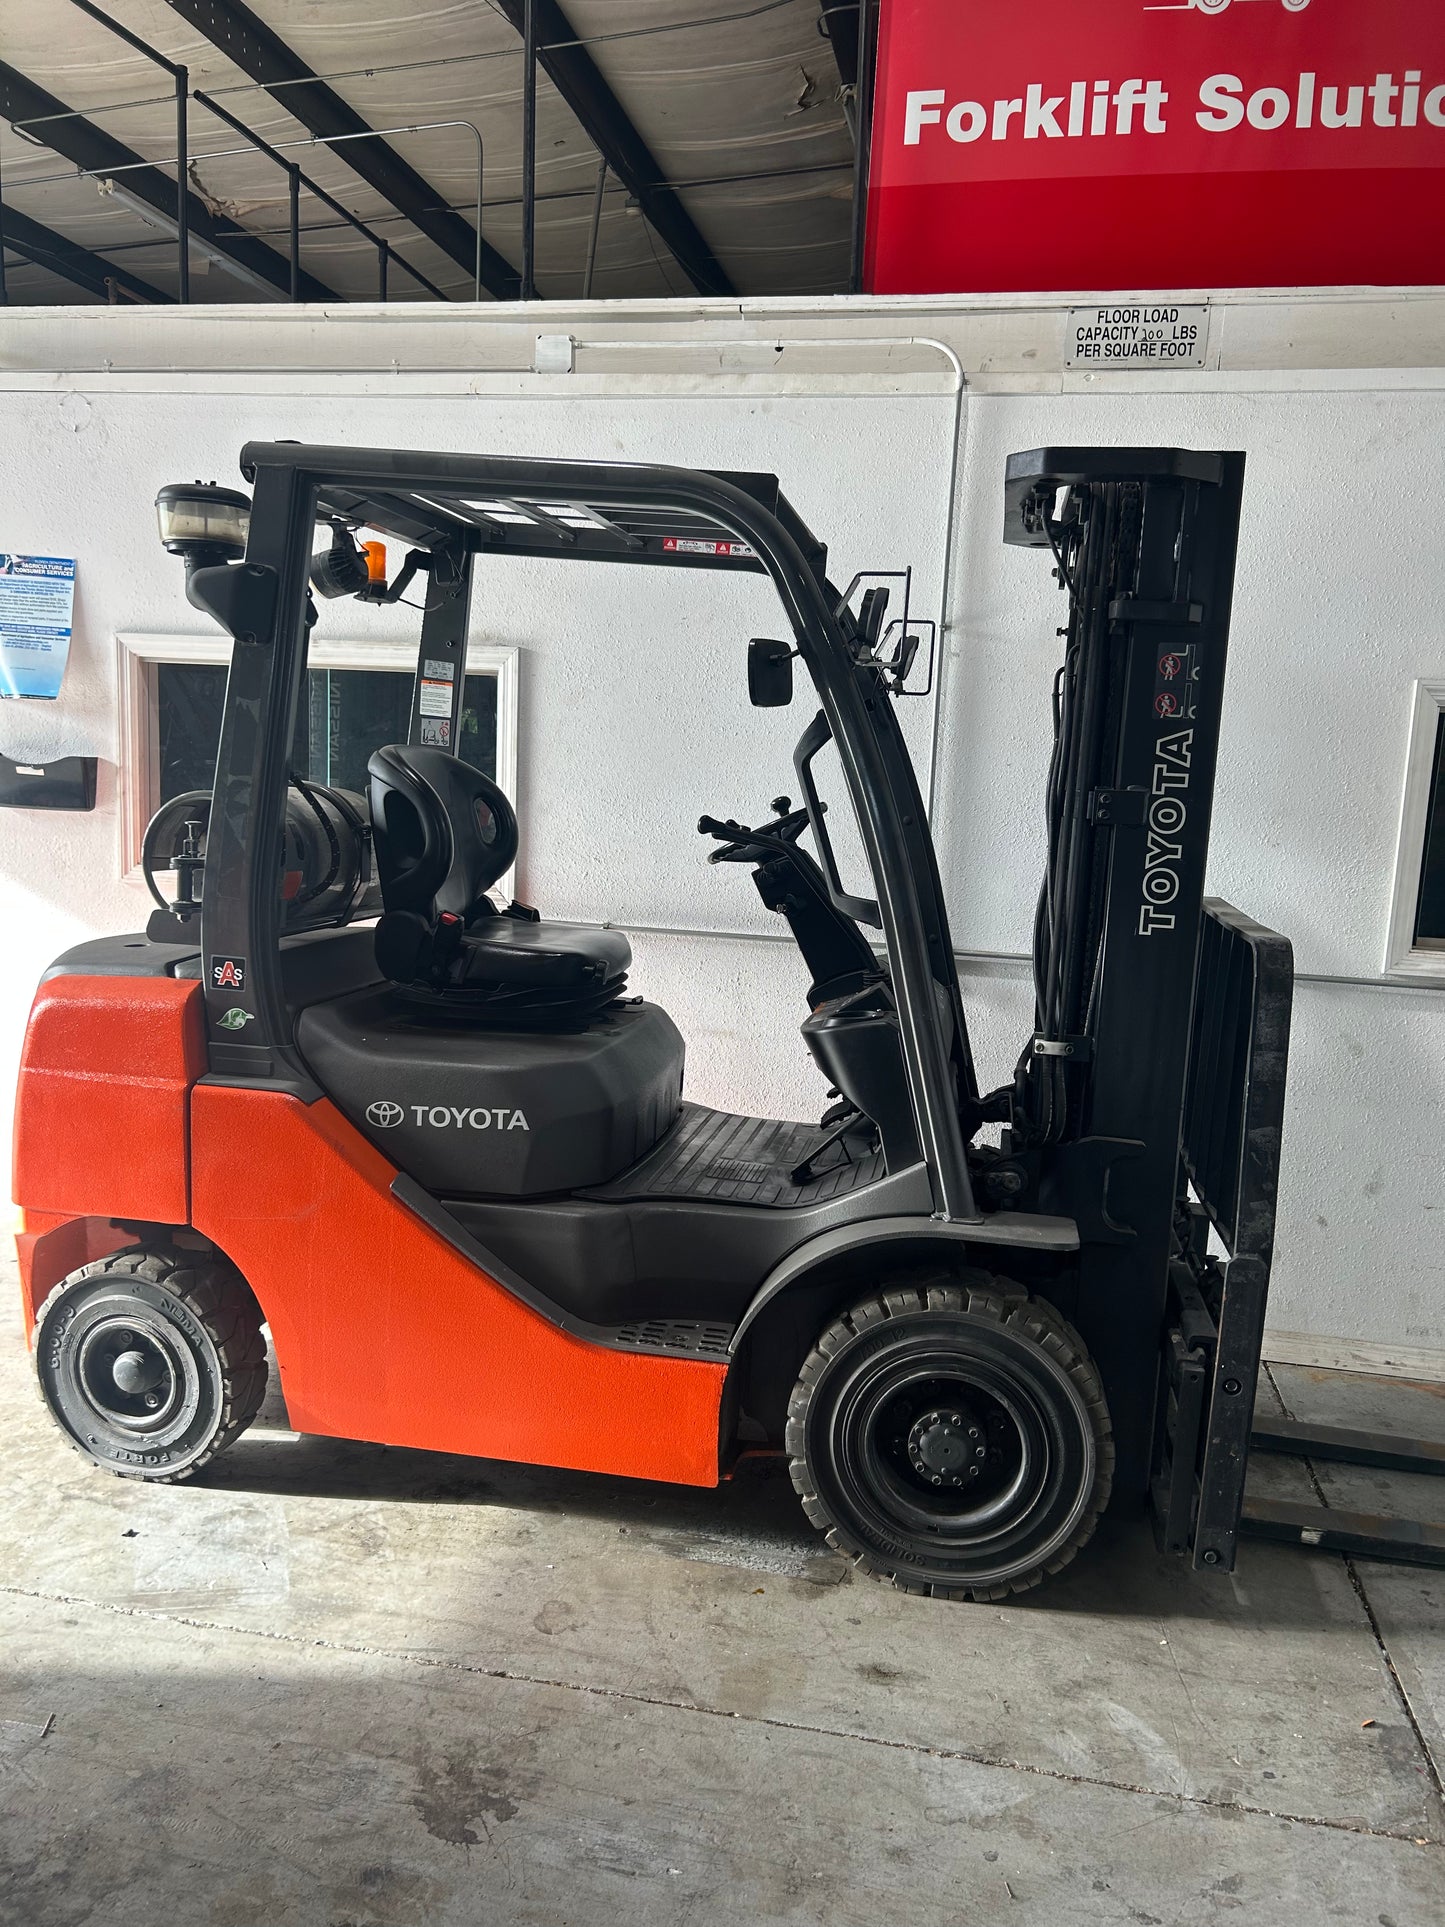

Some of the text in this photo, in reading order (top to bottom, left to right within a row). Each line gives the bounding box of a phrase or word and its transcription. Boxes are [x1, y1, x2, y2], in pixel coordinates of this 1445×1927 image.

[903, 78, 1169, 145] Forklift
[1097, 308, 1179, 324] FLOOR LOAD
[1076, 326, 1139, 341] CAPACITY
[1172, 325, 1198, 340] LBS
[1076, 342, 1195, 358] PER SQUARE FOOT
[14, 567, 74, 577] CONSUMER SERVICES
[1138, 728, 1194, 936] TOYOTA
[213, 960, 243, 987] SAS
[410, 1105, 530, 1131] TOYOTA
